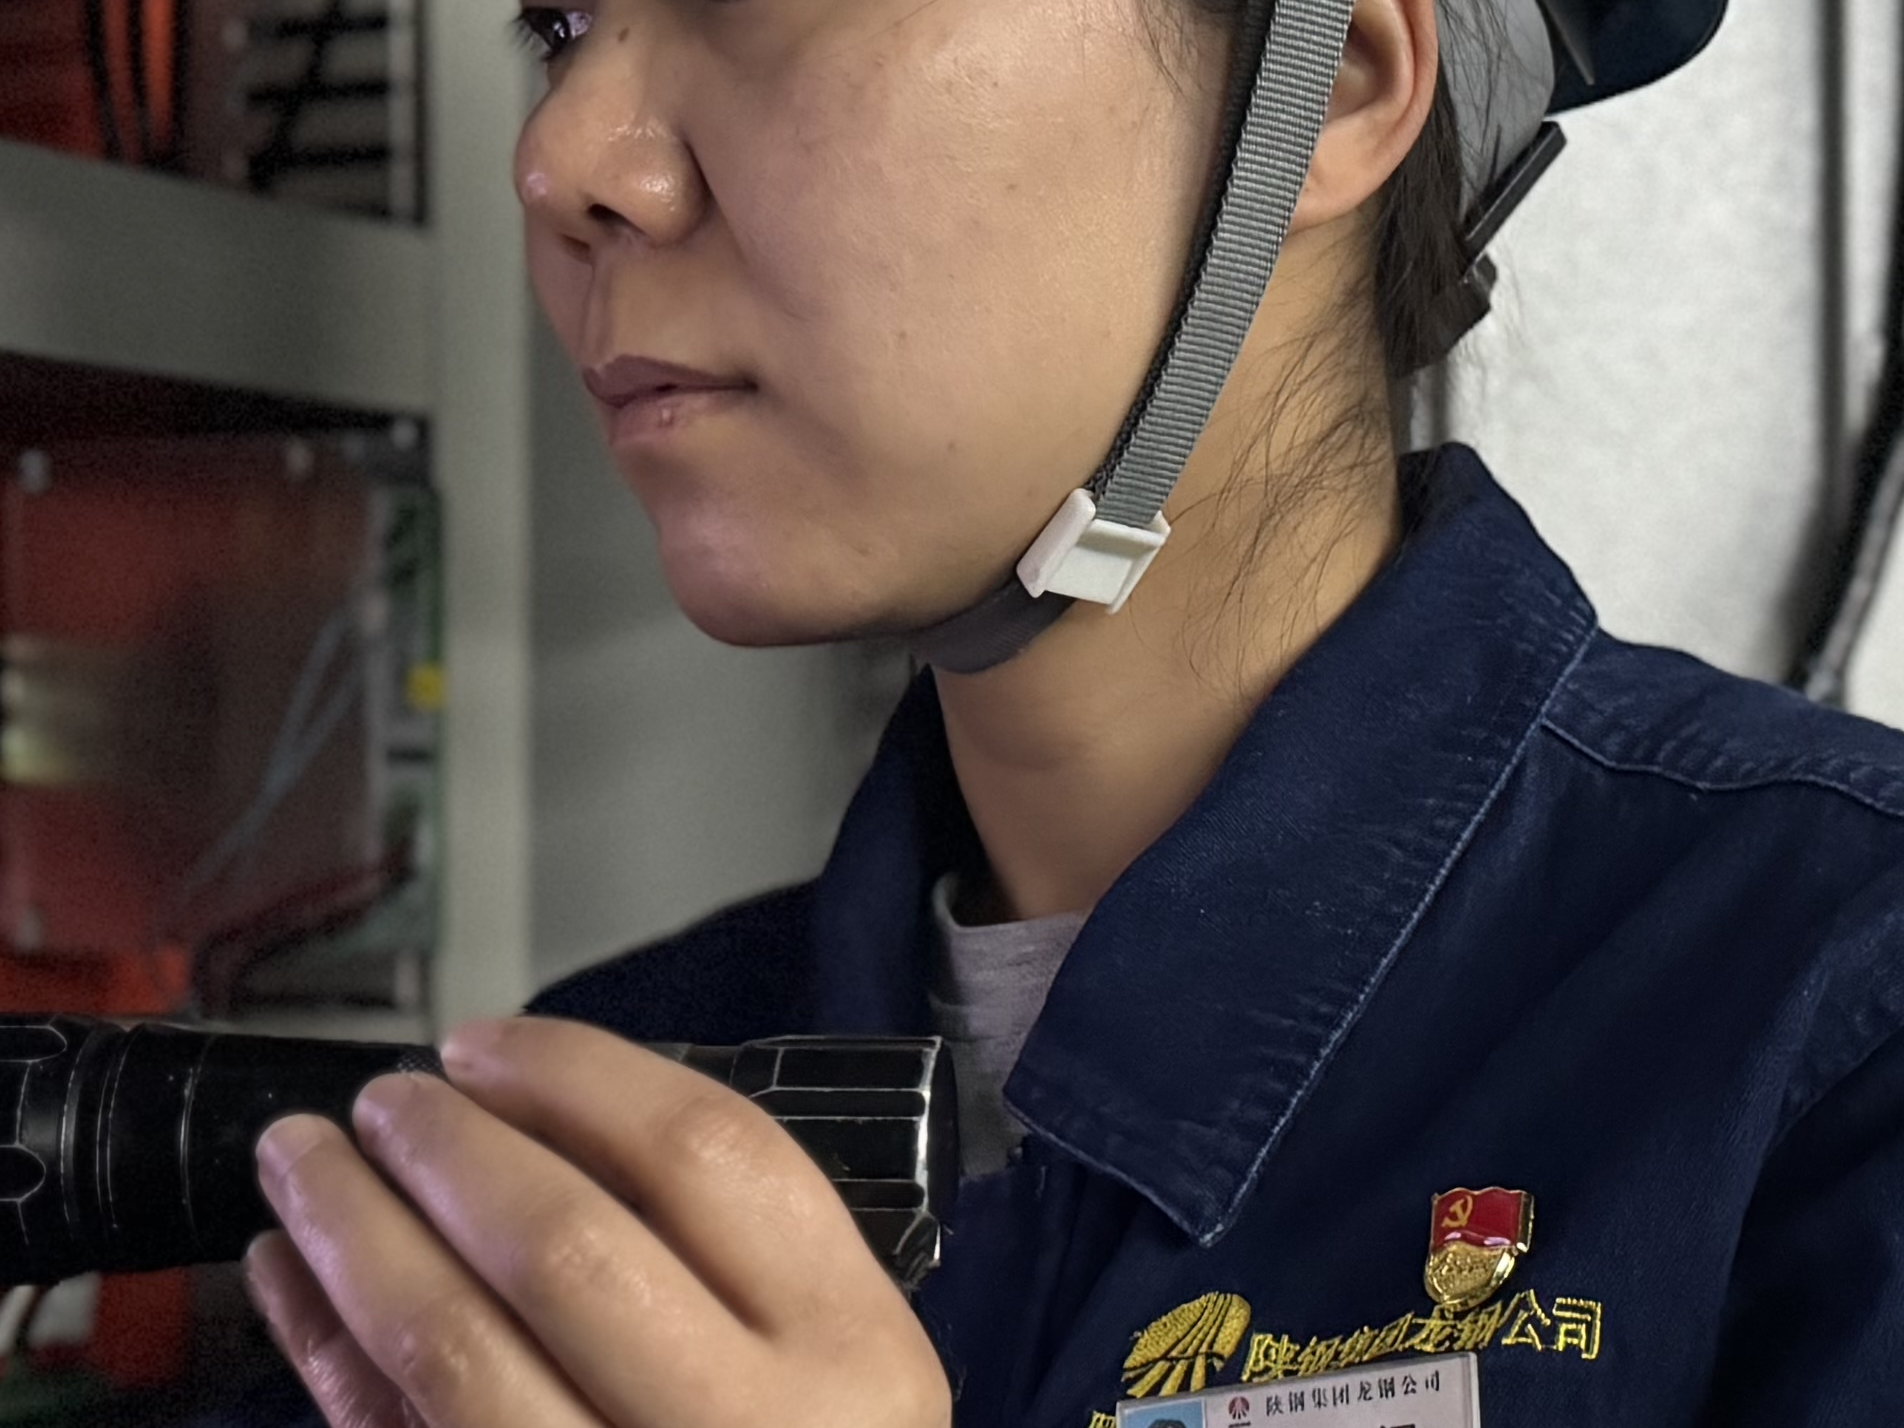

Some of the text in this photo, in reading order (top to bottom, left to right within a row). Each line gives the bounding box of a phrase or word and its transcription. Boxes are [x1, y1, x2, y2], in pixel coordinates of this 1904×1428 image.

[1264, 1369, 1441, 1416] 陕钢集团龙钢公司
